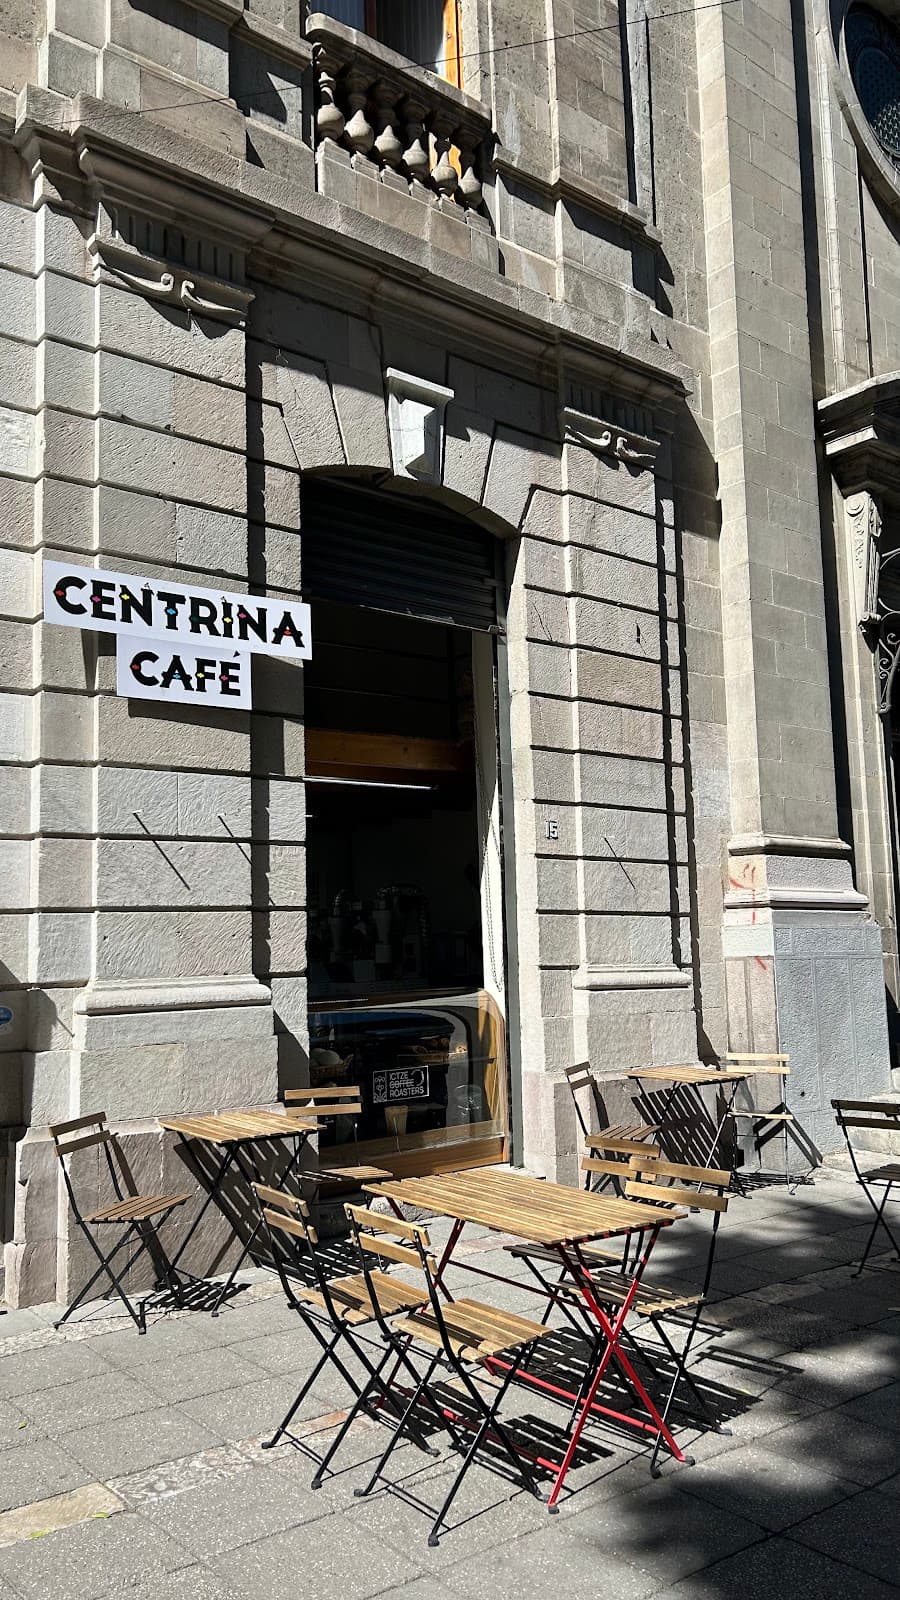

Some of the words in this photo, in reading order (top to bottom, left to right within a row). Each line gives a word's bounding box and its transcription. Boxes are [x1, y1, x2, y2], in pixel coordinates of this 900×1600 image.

[53, 575, 305, 648] CENTRINA
[130, 651, 241, 697] CAFÉ
[389, 1079, 415, 1089] COFFEE
[389, 1086, 425, 1098] ROASTERS
